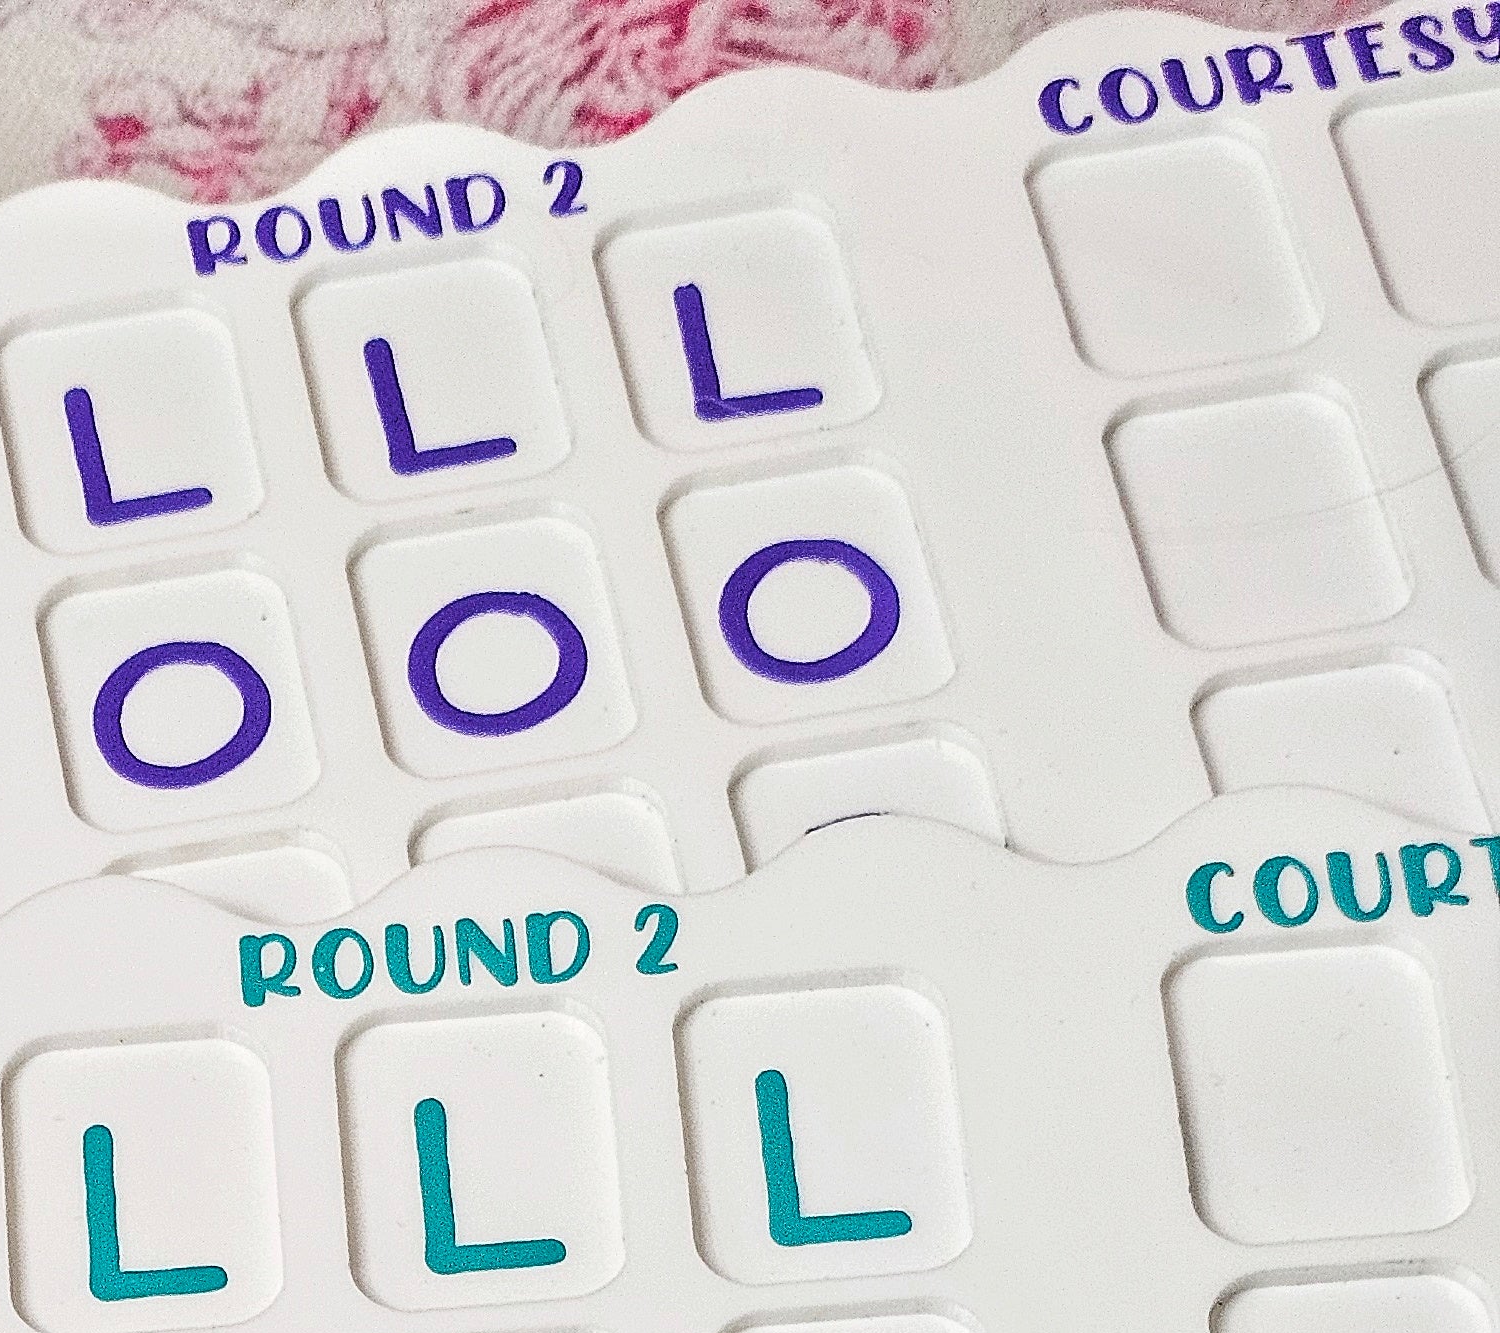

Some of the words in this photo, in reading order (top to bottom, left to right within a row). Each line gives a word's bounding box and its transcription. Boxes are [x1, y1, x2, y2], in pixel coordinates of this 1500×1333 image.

[1038, 1, 1500, 134] COURTESY
[185, 175, 505, 274] ROUND
[545, 160, 586, 216] 2
[64, 388, 212, 525] L
[364, 338, 516, 474] L
[674, 284, 823, 420] L
[93, 642, 271, 788] O
[408, 592, 587, 736] O
[719, 539, 900, 683] O
[240, 915, 590, 1007] ROUND
[635, 904, 678, 974] 2
[83, 1125, 228, 1301] L
[415, 1098, 566, 1274] L
[756, 1070, 912, 1246] L
